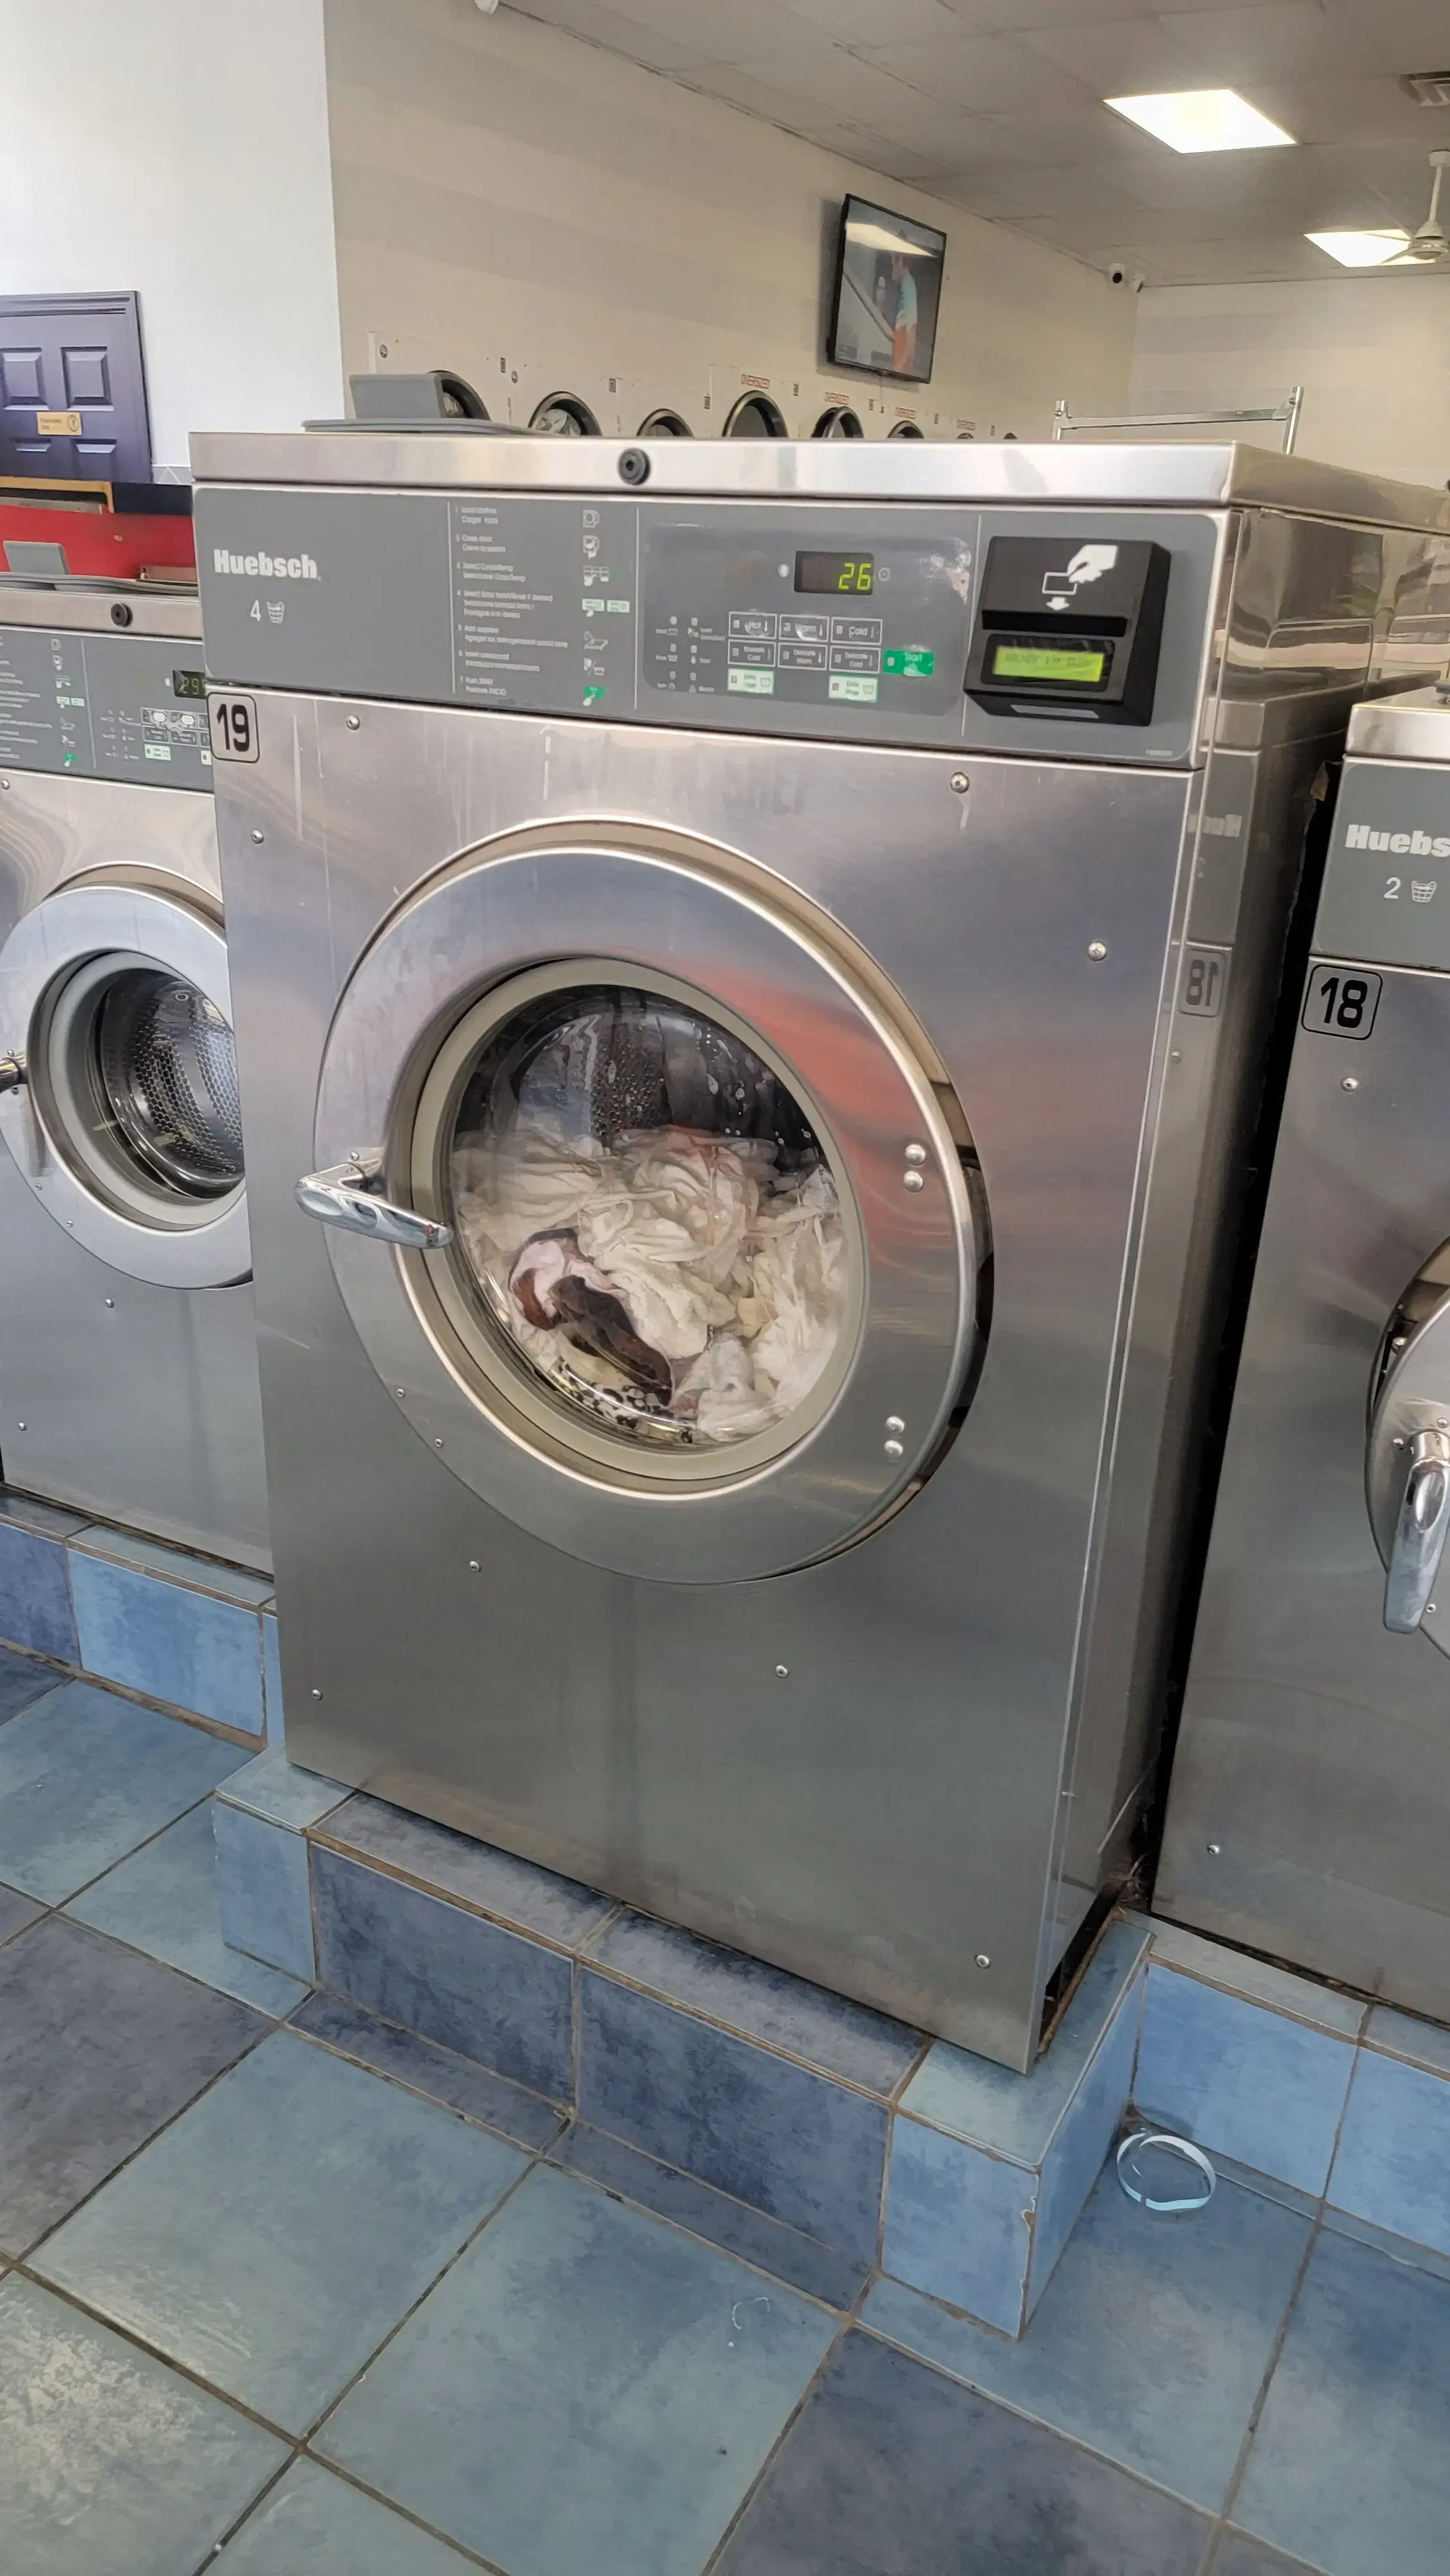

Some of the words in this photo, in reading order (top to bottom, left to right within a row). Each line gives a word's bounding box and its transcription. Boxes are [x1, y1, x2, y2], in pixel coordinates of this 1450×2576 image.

[213, 549, 319, 580] Huebsch
[839, 562, 872, 591] 26
[250, 600, 261, 622] 4
[849, 626, 869, 636] Cold
[216, 703, 250, 752] 19
[1384, 876, 1401, 900] 2
[1320, 976, 1369, 1029] 18
